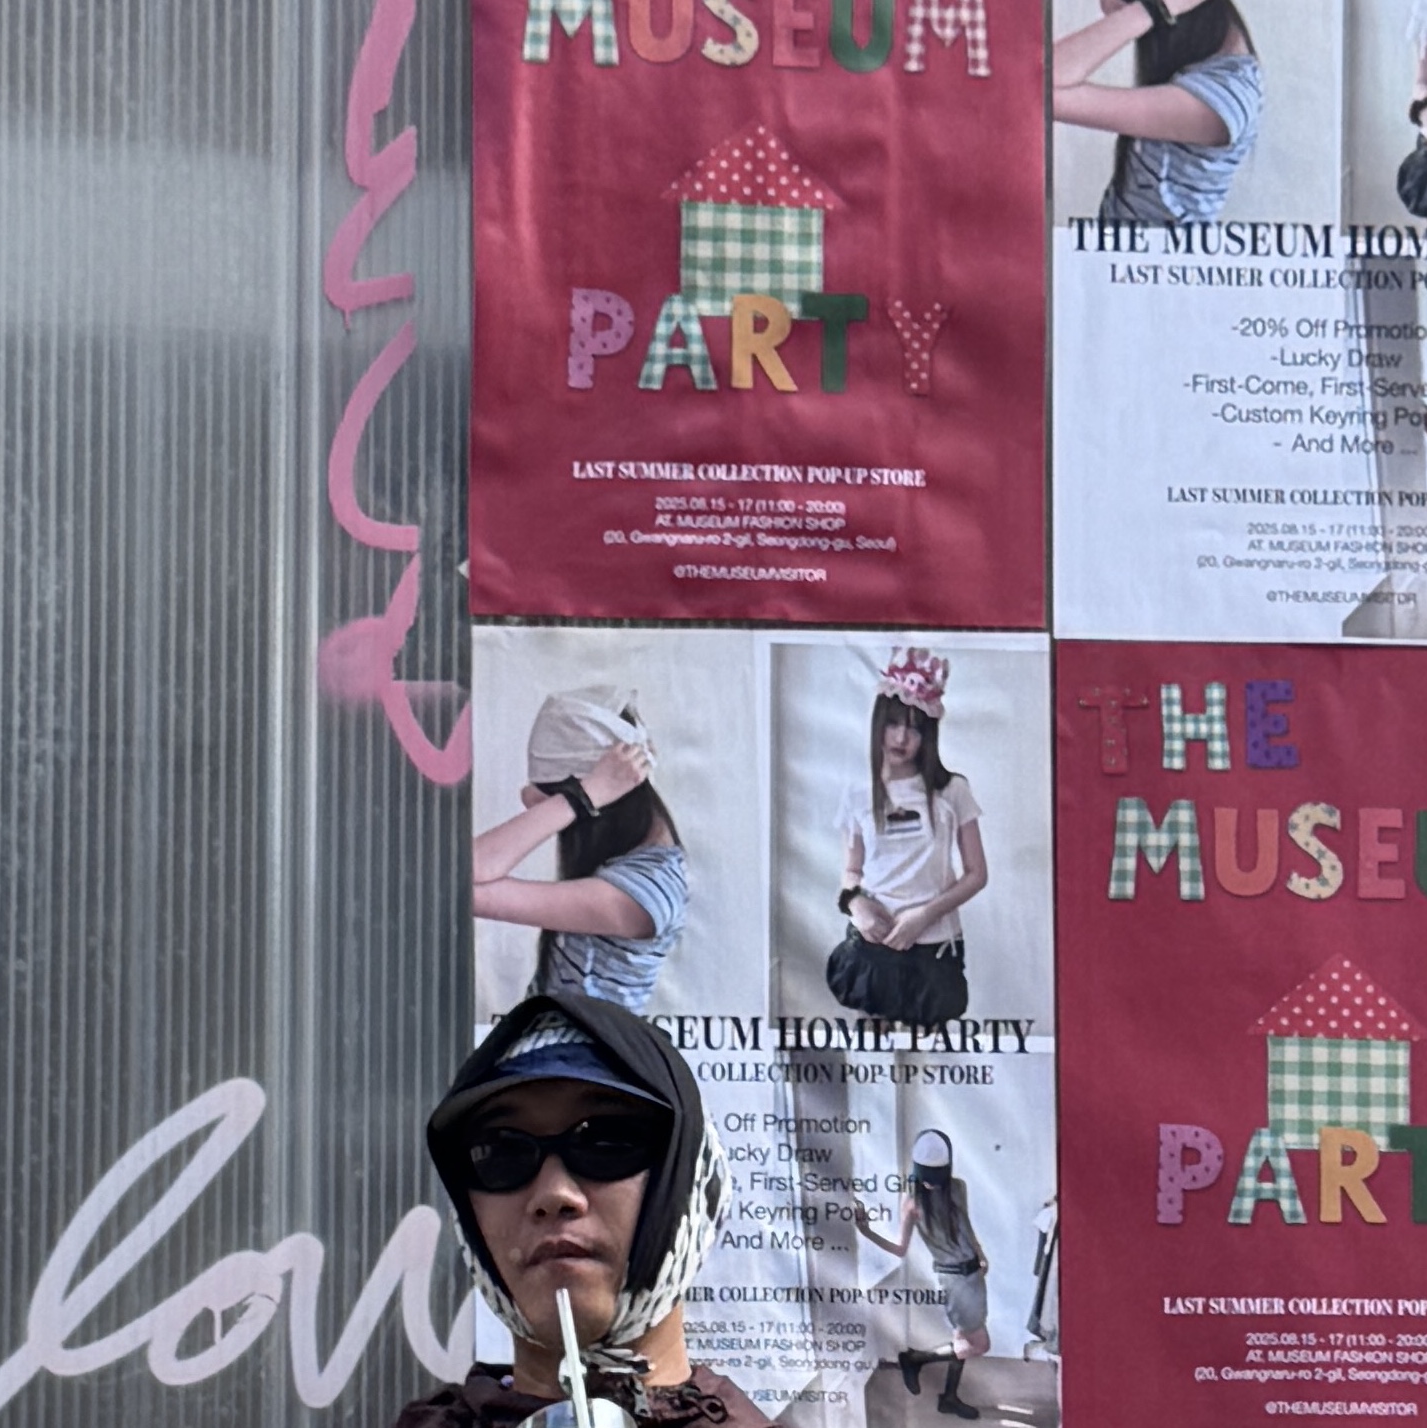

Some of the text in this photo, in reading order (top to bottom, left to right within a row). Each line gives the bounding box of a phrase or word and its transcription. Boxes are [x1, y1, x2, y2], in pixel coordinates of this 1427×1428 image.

[1069, 217, 1149, 253] THE
[1164, 222, 1334, 258] MUSEUM
[1110, 264, 1163, 285] LAST
[1171, 265, 1264, 287] SUMMER
[1271, 268, 1403, 290] COLLECTION
[1231, 318, 1288, 338] -20%
[1296, 318, 1326, 338] Off
[567, 287, 949, 396] PARTY
[1271, 348, 1402, 372] -Lucky Draw
[1184, 375, 1314, 398] -First-Come,
[1212, 403, 1303, 424] -Custom
[1310, 405, 1387, 429] Keyring
[1291, 434, 1394, 454] And More
[573, 461, 615, 479] LAST
[618, 463, 694, 480] SUMMER
[698, 463, 802, 482] COLLECTION
[871, 468, 926, 486] STORE
[1168, 486, 1208, 502] LAST
[1212, 488, 1285, 504] SUMMER
[1290, 489, 1392, 506] COLLECTION
[677, 516, 739, 528] MUSEUM
[806, 517, 845, 530] SHOP
[1269, 541, 1330, 552] MUSEUM
[1079, 678, 1299, 774] THE
[652, 1014, 1035, 1054] SEUM HOME PARTY
[698, 1062, 993, 1085] COLLECTION POP-UP STORE
[724, 1113, 871, 1134] Off Promotion
[778, 1143, 832, 1162] Draw
[750, 1172, 878, 1193] First-Served
[739, 1201, 817, 1226] Keyring
[723, 1231, 824, 1251] And More
[719, 1287, 823, 1302] COLLECTION
[893, 1289, 948, 1306] STORE
[1163, 1297, 1206, 1315] LAST
[1209, 1298, 1284, 1315] SUMMER
[1288, 1298, 1393, 1316] COLLECTION
[760, 1322, 772, 1333] 17
[699, 1338, 866, 1351] MUSEUM FASHION SHOP
[1329, 1333, 1342, 1346] 17
[1268, 1351, 1331, 1363] MUSEUM
[1334, 1351, 1393, 1364] FASHION
